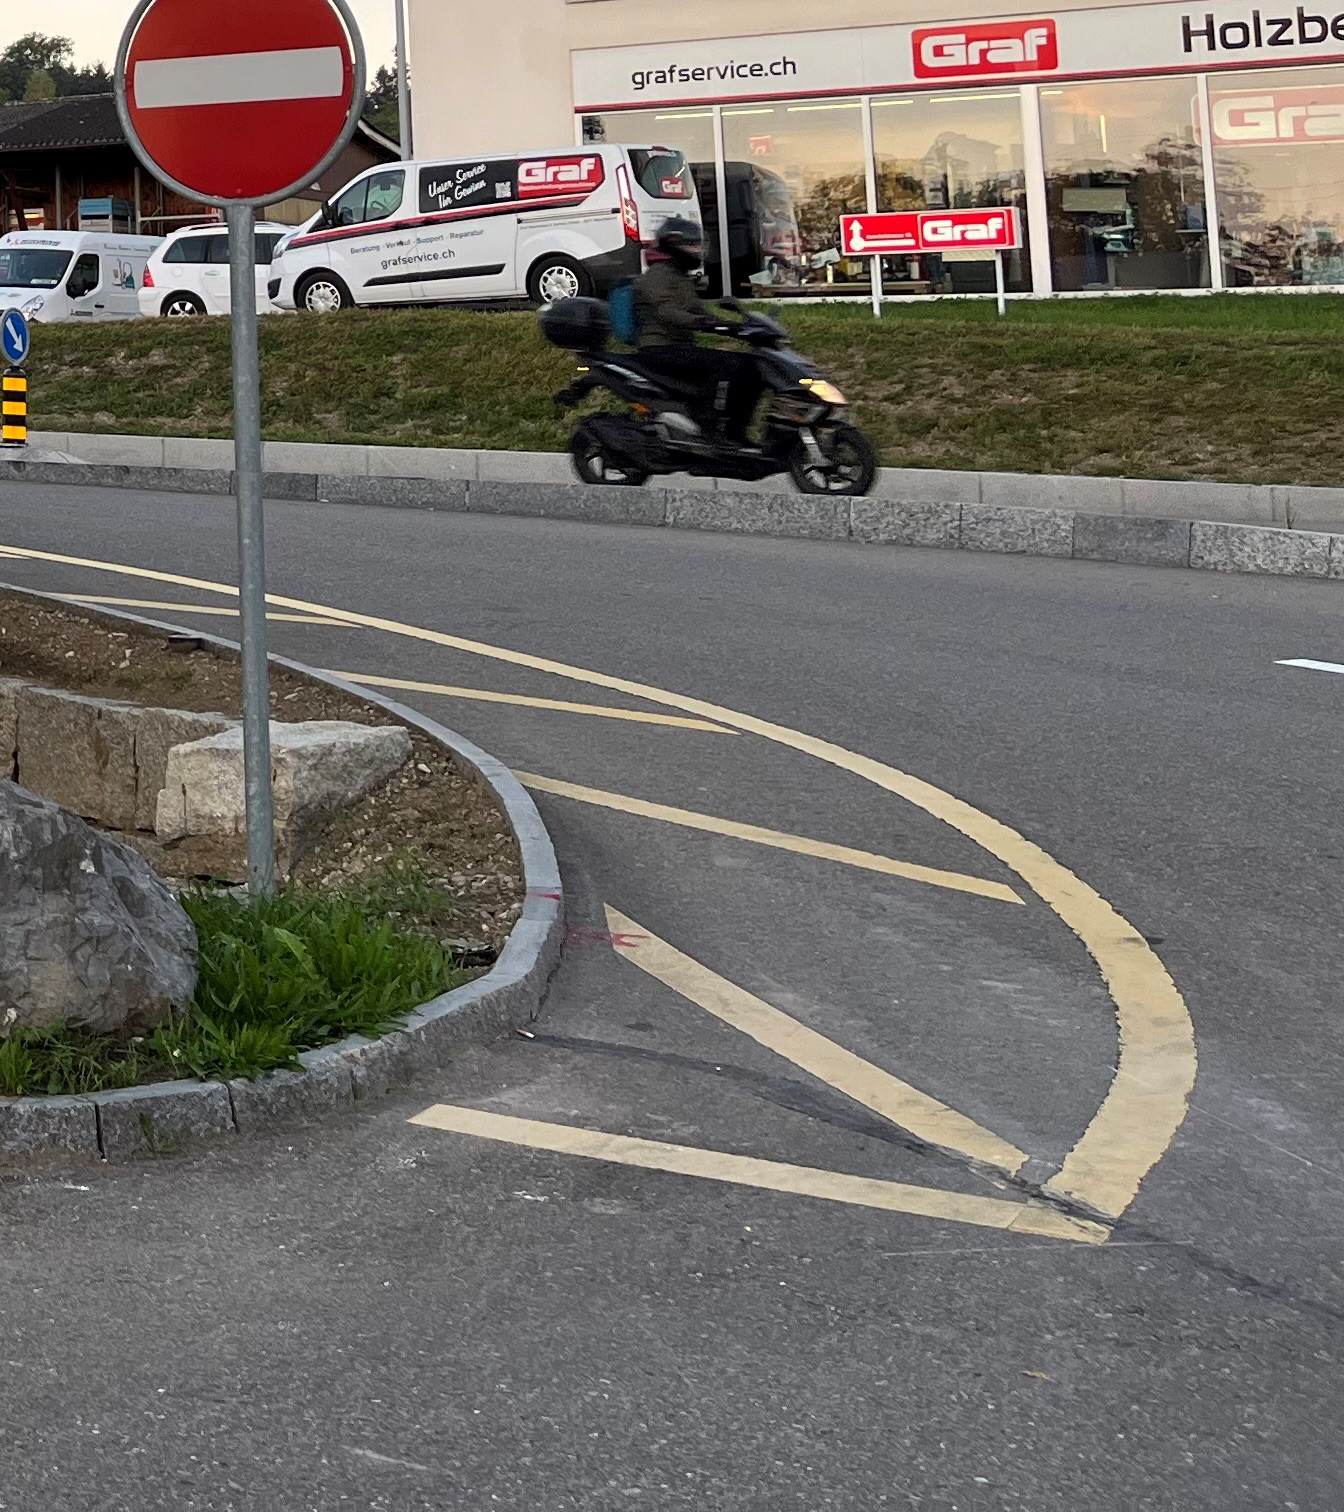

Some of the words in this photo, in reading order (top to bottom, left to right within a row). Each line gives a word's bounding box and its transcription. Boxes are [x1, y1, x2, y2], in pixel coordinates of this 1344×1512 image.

[920, 27, 1048, 68] Graf
[631, 56, 797, 90] grafservice.ch
[428, 181, 453, 197] Unser
[456, 163, 487, 184] Service
[519, 157, 595, 183] Graf
[438, 194, 452, 209] Ihr
[454, 179, 487, 200] Gewinn
[922, 217, 1004, 242] Graf
[381, 248, 456, 270] grafservice.ch
